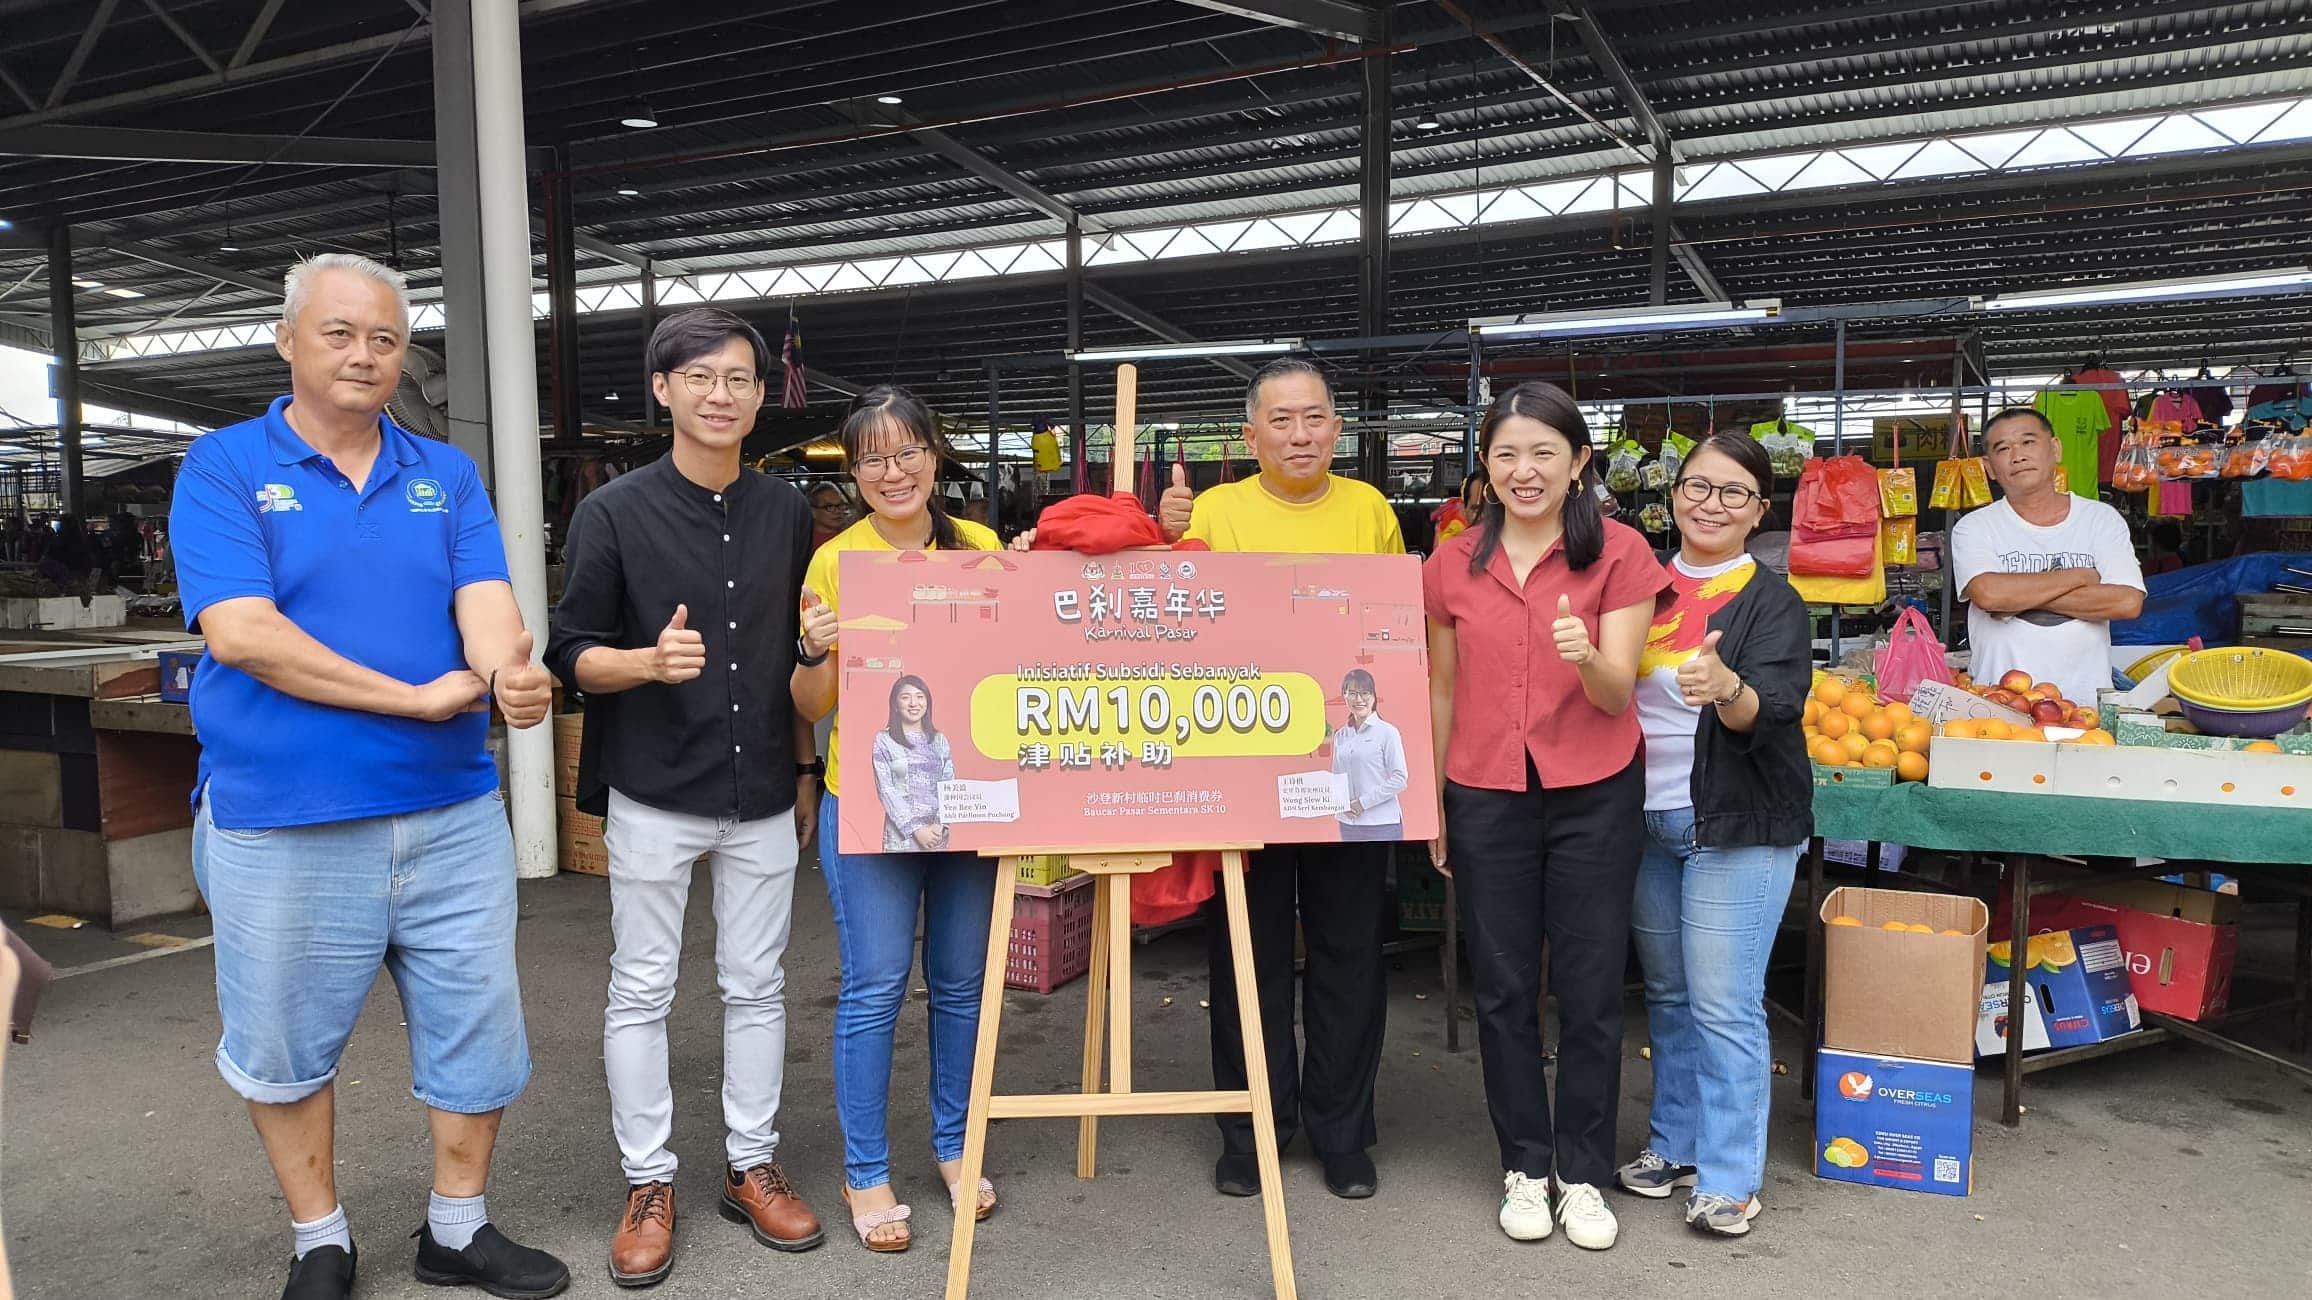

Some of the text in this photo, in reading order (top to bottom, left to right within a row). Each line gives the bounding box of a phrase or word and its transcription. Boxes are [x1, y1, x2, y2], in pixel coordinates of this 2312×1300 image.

[1053, 583, 1226, 623] 巴刹嘉年华
[1084, 624, 1198, 643] Karnival Pasar
[1016, 662, 1262, 683] Inisiatif Subsidi Sebanyak
[1016, 685, 1291, 744] RM10,000
[1018, 741, 1173, 770] 津贴补助
[1083, 806, 1118, 816] Baucar
[1119, 806, 1146, 816] Pasar
[1147, 805, 1199, 816] Sementara
[1878, 1087, 1952, 1104] OVERSEAS
[1914, 1101, 1937, 1109] CITRUS
